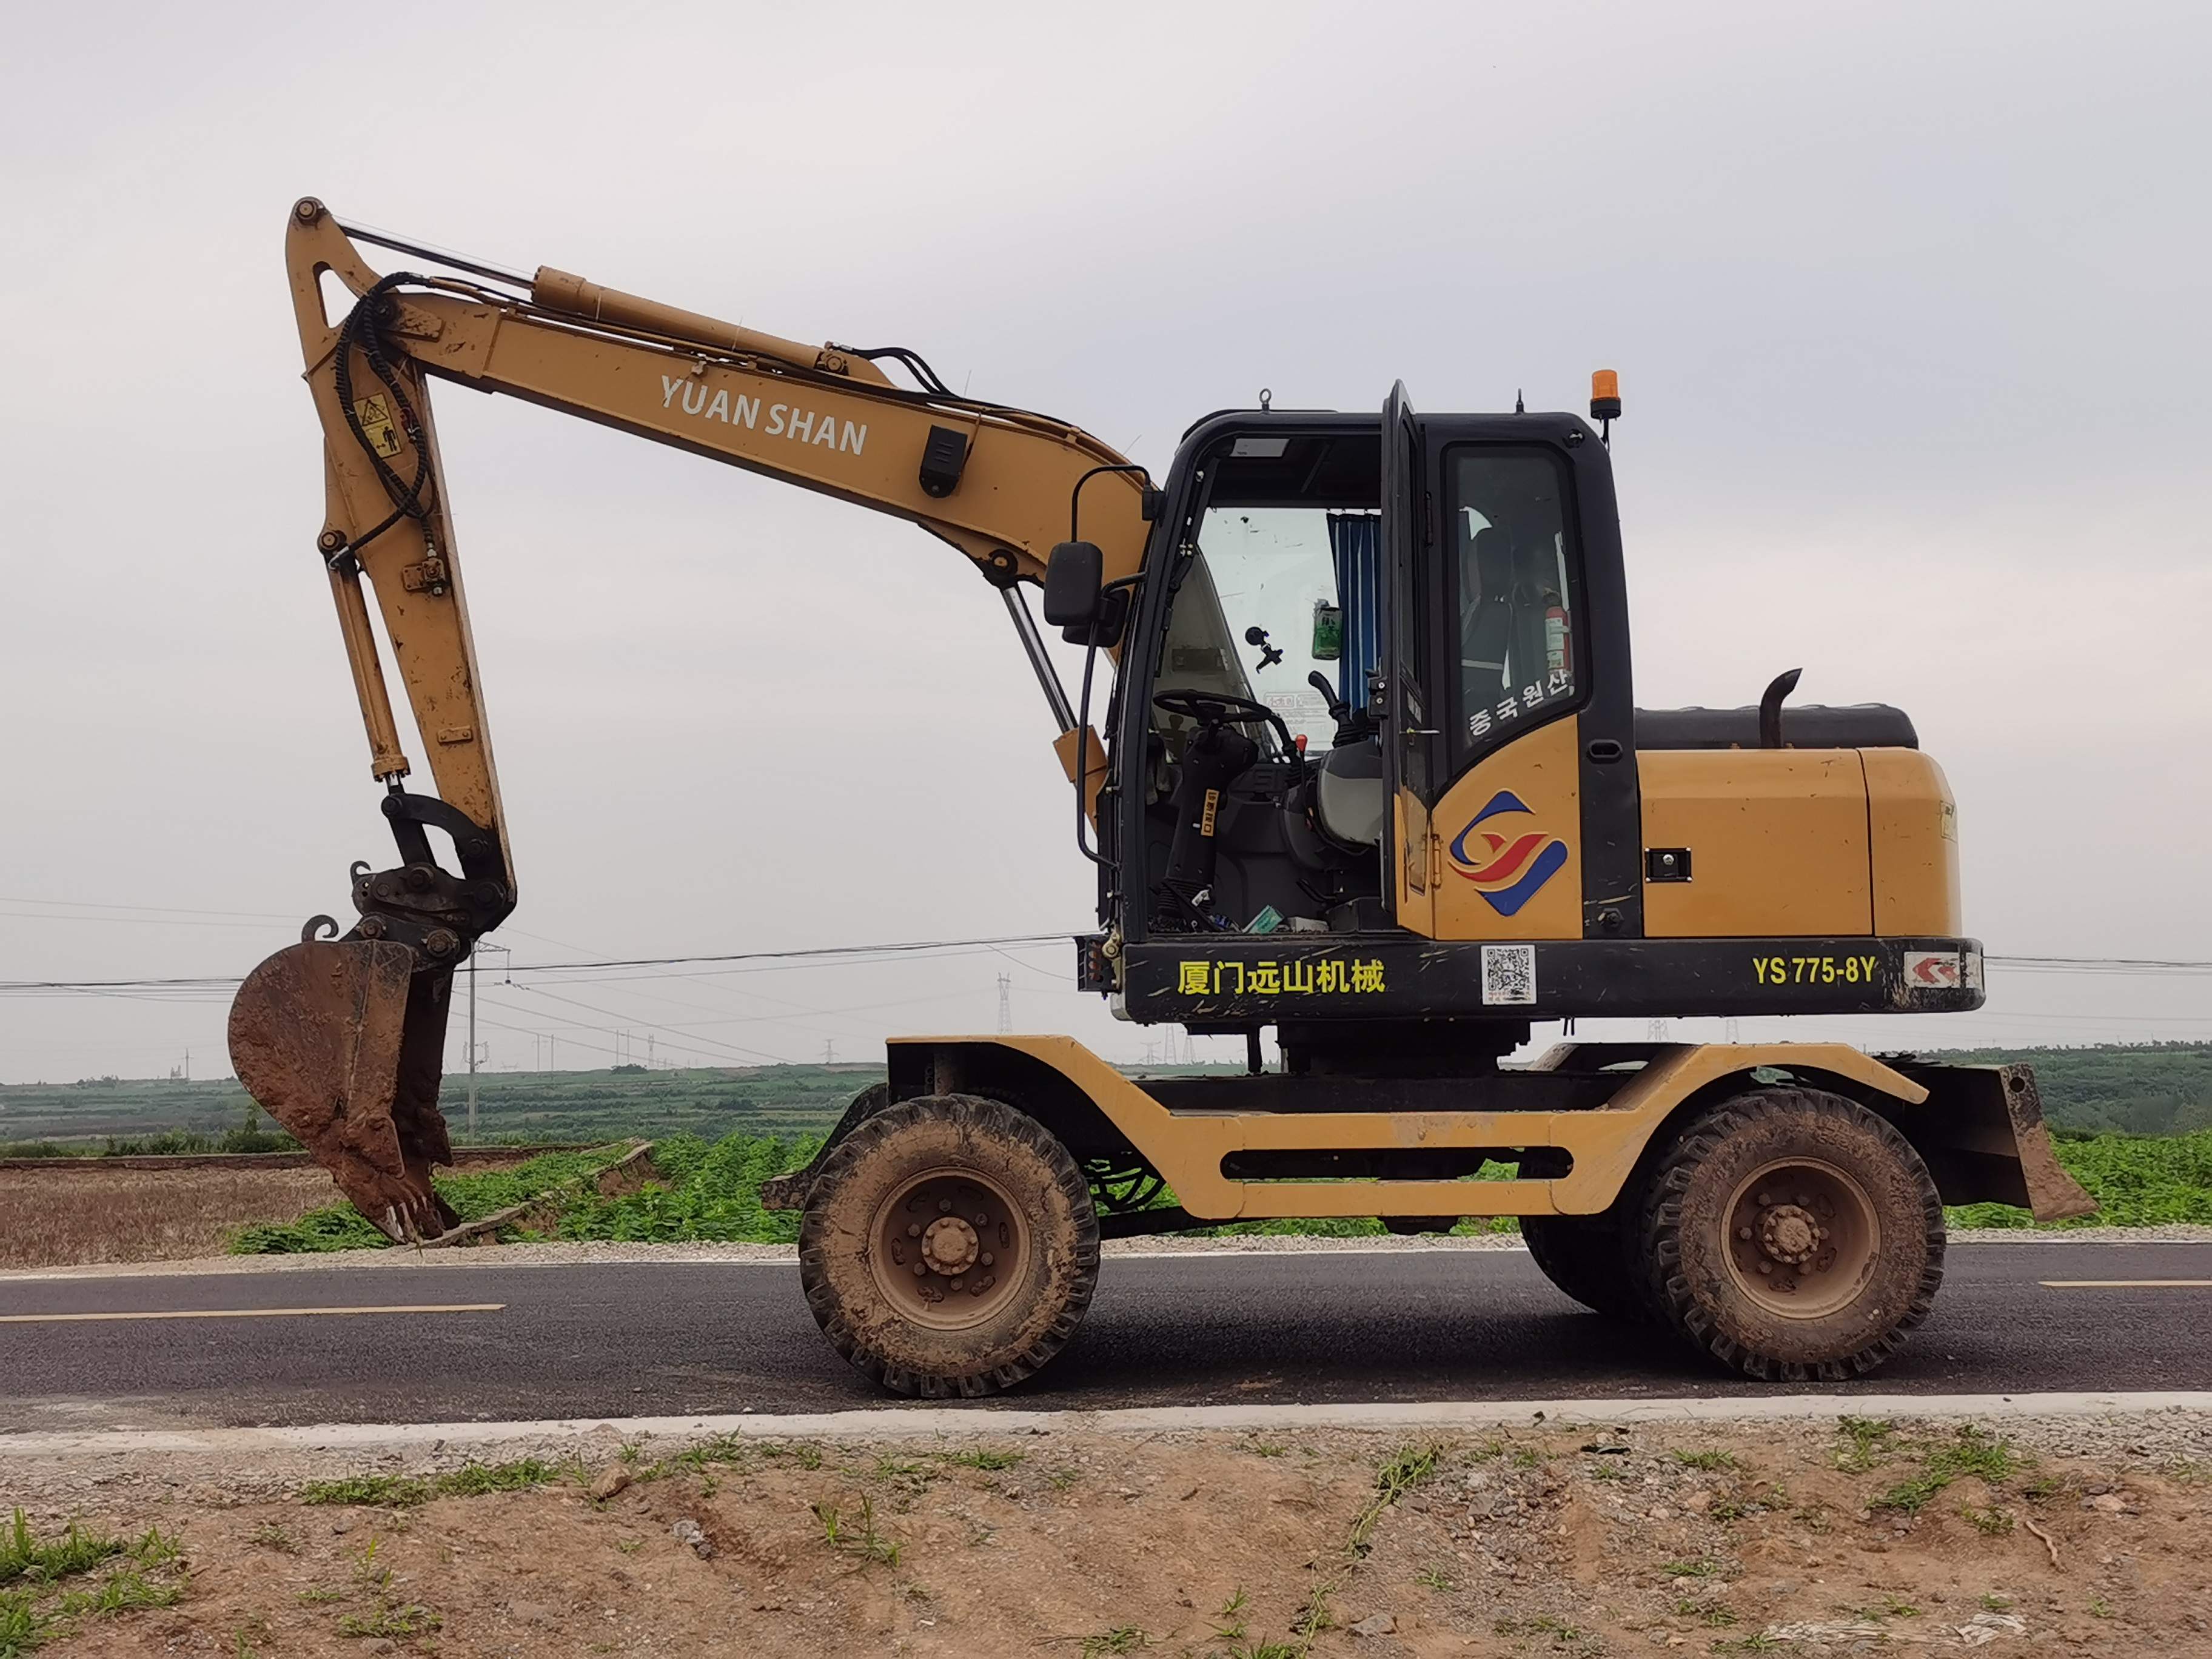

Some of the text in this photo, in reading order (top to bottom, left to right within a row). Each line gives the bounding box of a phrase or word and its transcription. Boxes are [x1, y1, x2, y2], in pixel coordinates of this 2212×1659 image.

[661, 375, 867, 455] YUAN SHAN
[1177, 959, 1386, 995] 厦门远山机械
